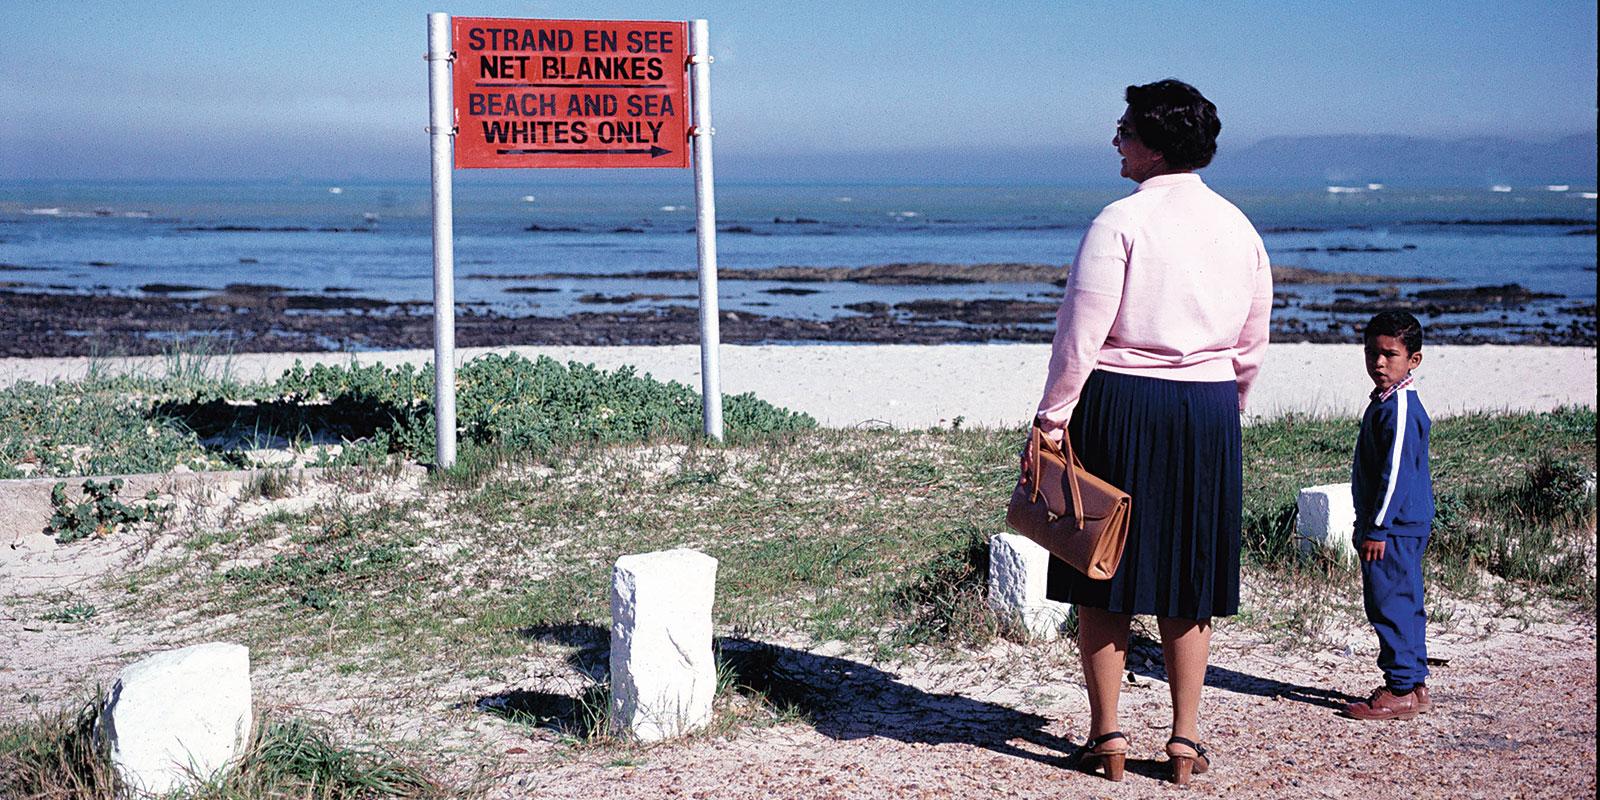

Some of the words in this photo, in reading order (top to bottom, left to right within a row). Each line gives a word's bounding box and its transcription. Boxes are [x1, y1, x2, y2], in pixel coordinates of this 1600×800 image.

[469, 28, 573, 52] STRAND
[584, 31, 617, 53] EN
[627, 31, 673, 53] SEE
[480, 56, 530, 79] NET
[542, 56, 663, 80] BLANKES
[469, 93, 556, 116] BEACH
[567, 94, 618, 116] AND
[627, 95, 675, 117] SEA
[482, 121, 588, 144] WHITES
[598, 121, 664, 144] ONLY
